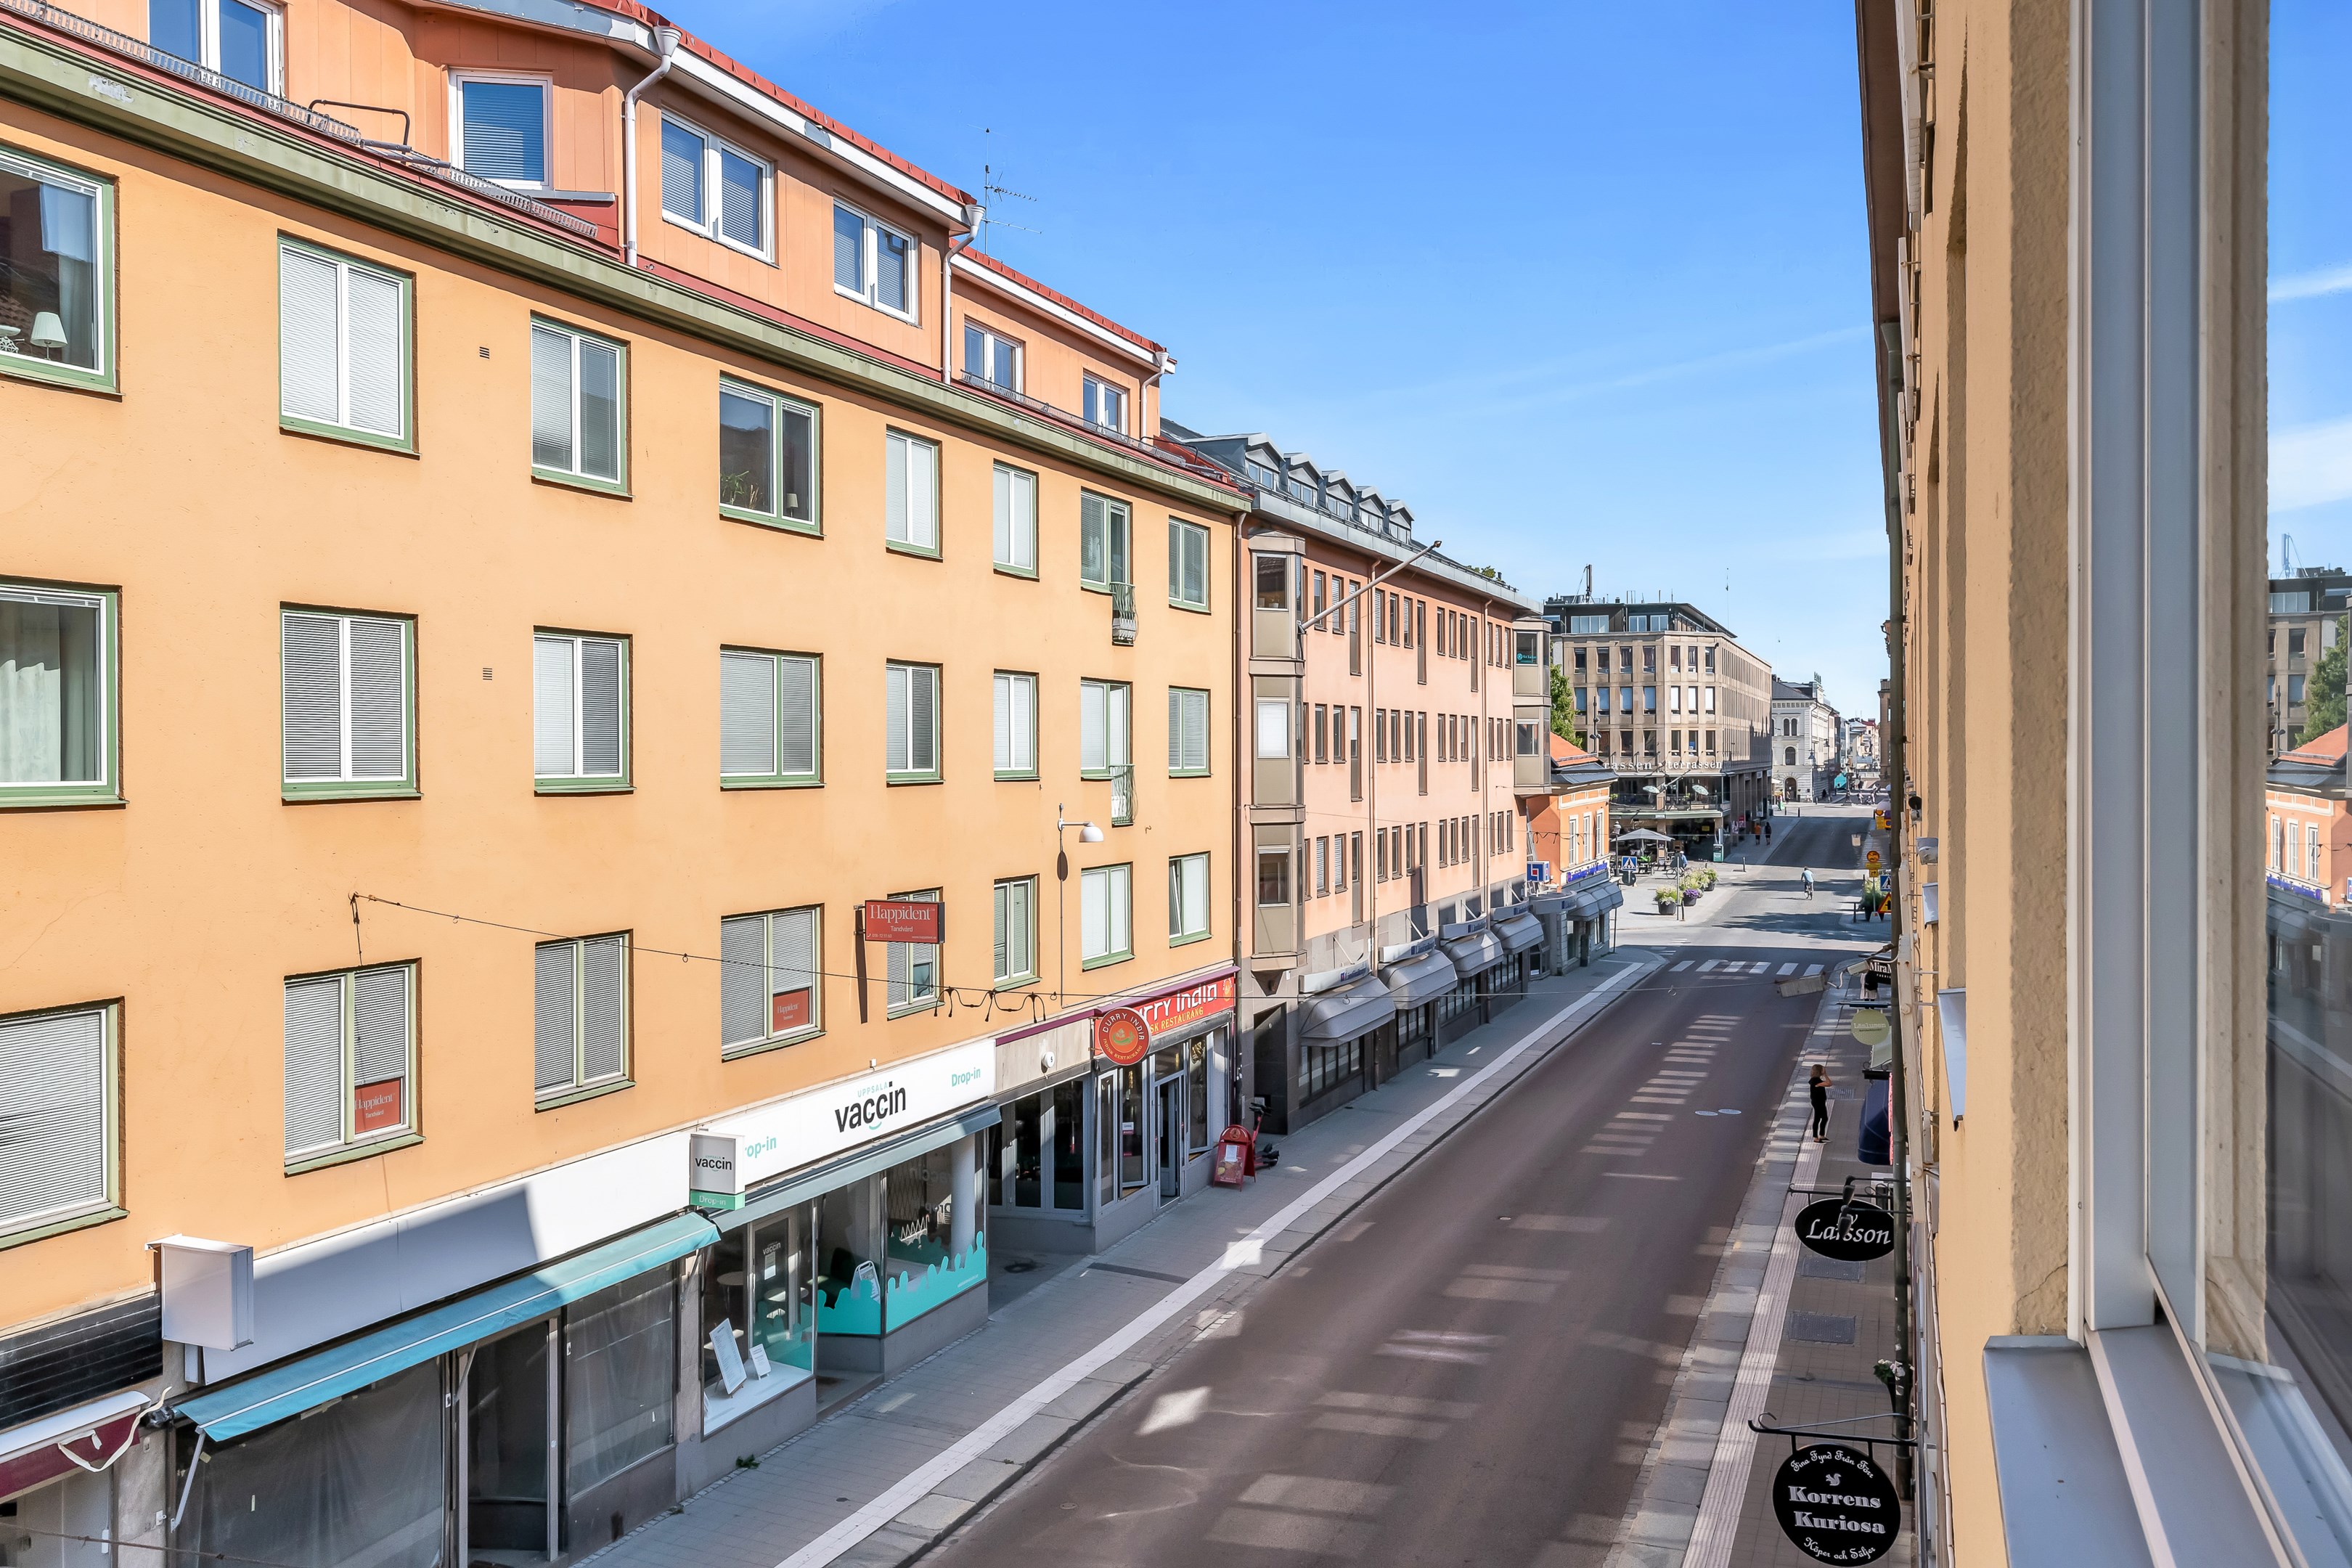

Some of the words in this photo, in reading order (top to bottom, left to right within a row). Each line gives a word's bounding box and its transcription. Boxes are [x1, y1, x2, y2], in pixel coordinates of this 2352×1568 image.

[870, 905, 931, 923] Happident
[1130, 1016, 1145, 1040] INDIA
[1161, 1006, 1204, 1030] RESTAURANG
[1103, 1038, 1114, 1055] INDISK
[1114, 1045, 1143, 1060] RESTAURANG
[952, 1067, 981, 1087] Drop-in
[857, 1082, 888, 1098] UPPSALA
[835, 1081, 906, 1133] vaccin
[745, 1136, 777, 1159] op-in
[695, 1156, 732, 1170] vaccin
[699, 1195, 726, 1206] Drop-in
[1791, 1459, 1810, 1472] Fina
[1810, 1450, 1833, 1463] Fynd
[1834, 1450, 1855, 1466] Från
[1857, 1460, 1874, 1479] Förr
[1788, 1486, 1881, 1508] Korrens
[1794, 1511, 1887, 1534] Kuriosa
[1804, 1537, 1831, 1557] Köper
[1834, 1551, 1847, 1560] och
[1850, 1546, 1876, 1559] Säljer
